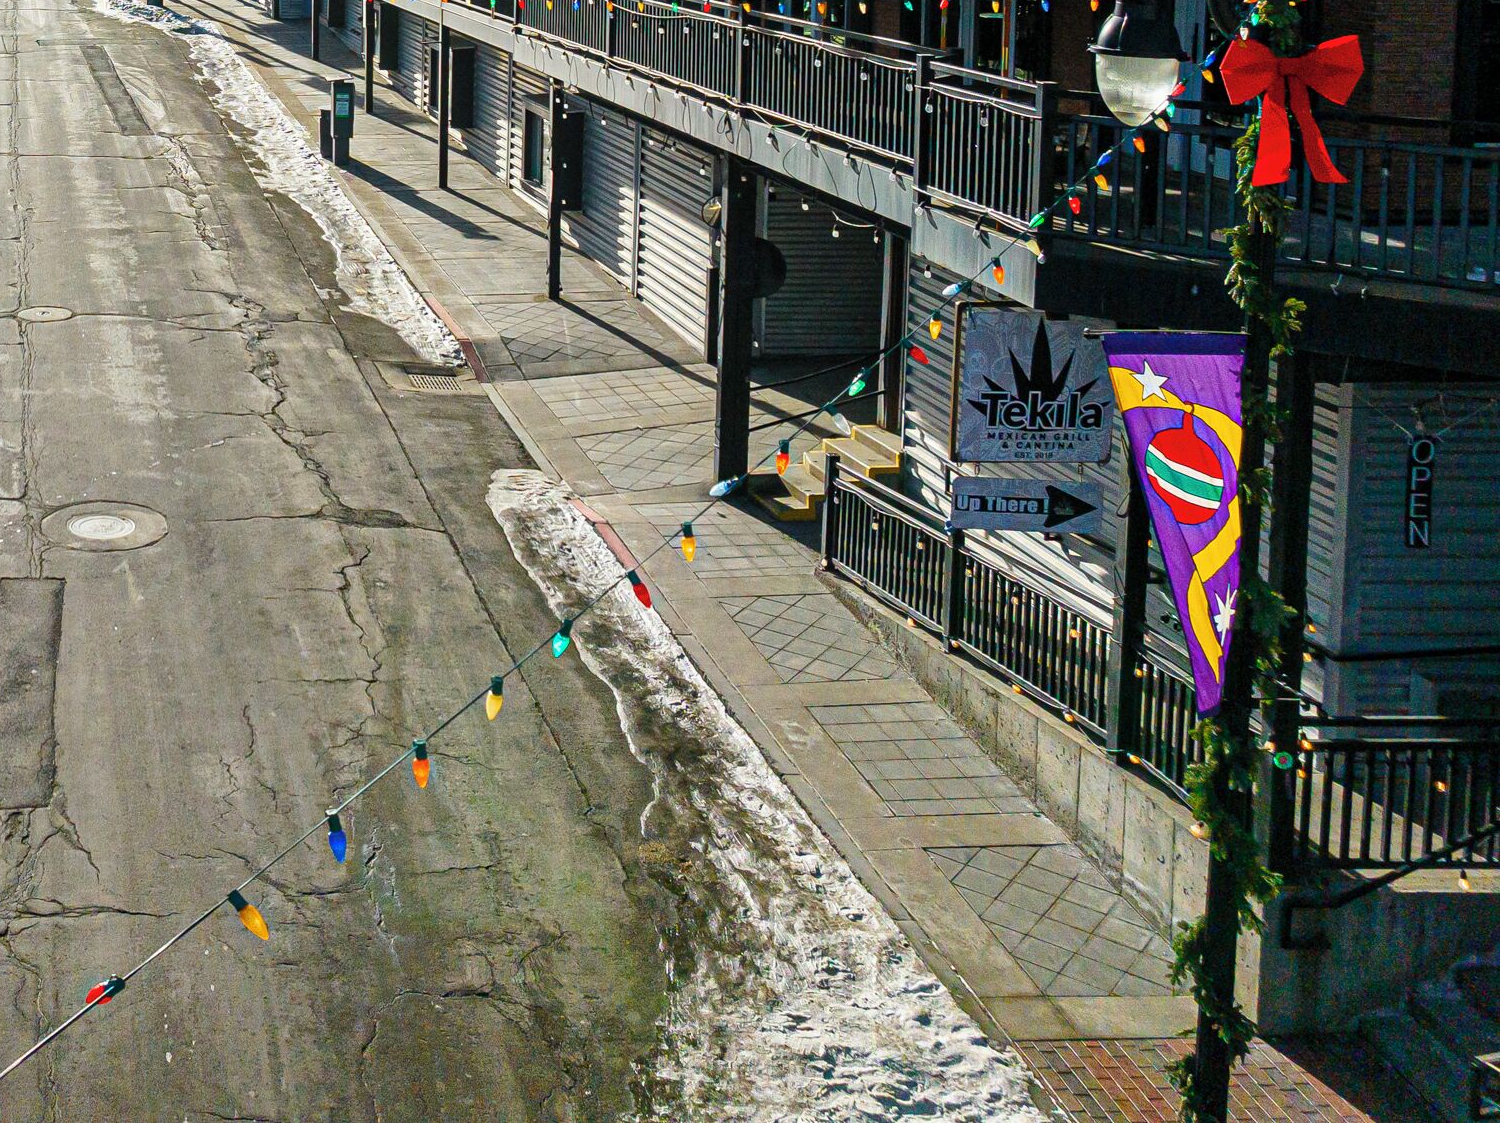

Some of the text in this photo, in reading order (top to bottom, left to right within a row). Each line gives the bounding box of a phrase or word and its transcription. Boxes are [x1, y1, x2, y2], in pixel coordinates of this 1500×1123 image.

[979, 389, 1105, 430] Tekila
[987, 431, 1091, 441] MEXICAN GRILL
[1001, 441, 1075, 450] & CANTINA
[1409, 439, 1435, 547] OPEN
[956, 494, 981, 512] Up
[986, 496, 1038, 513] There
